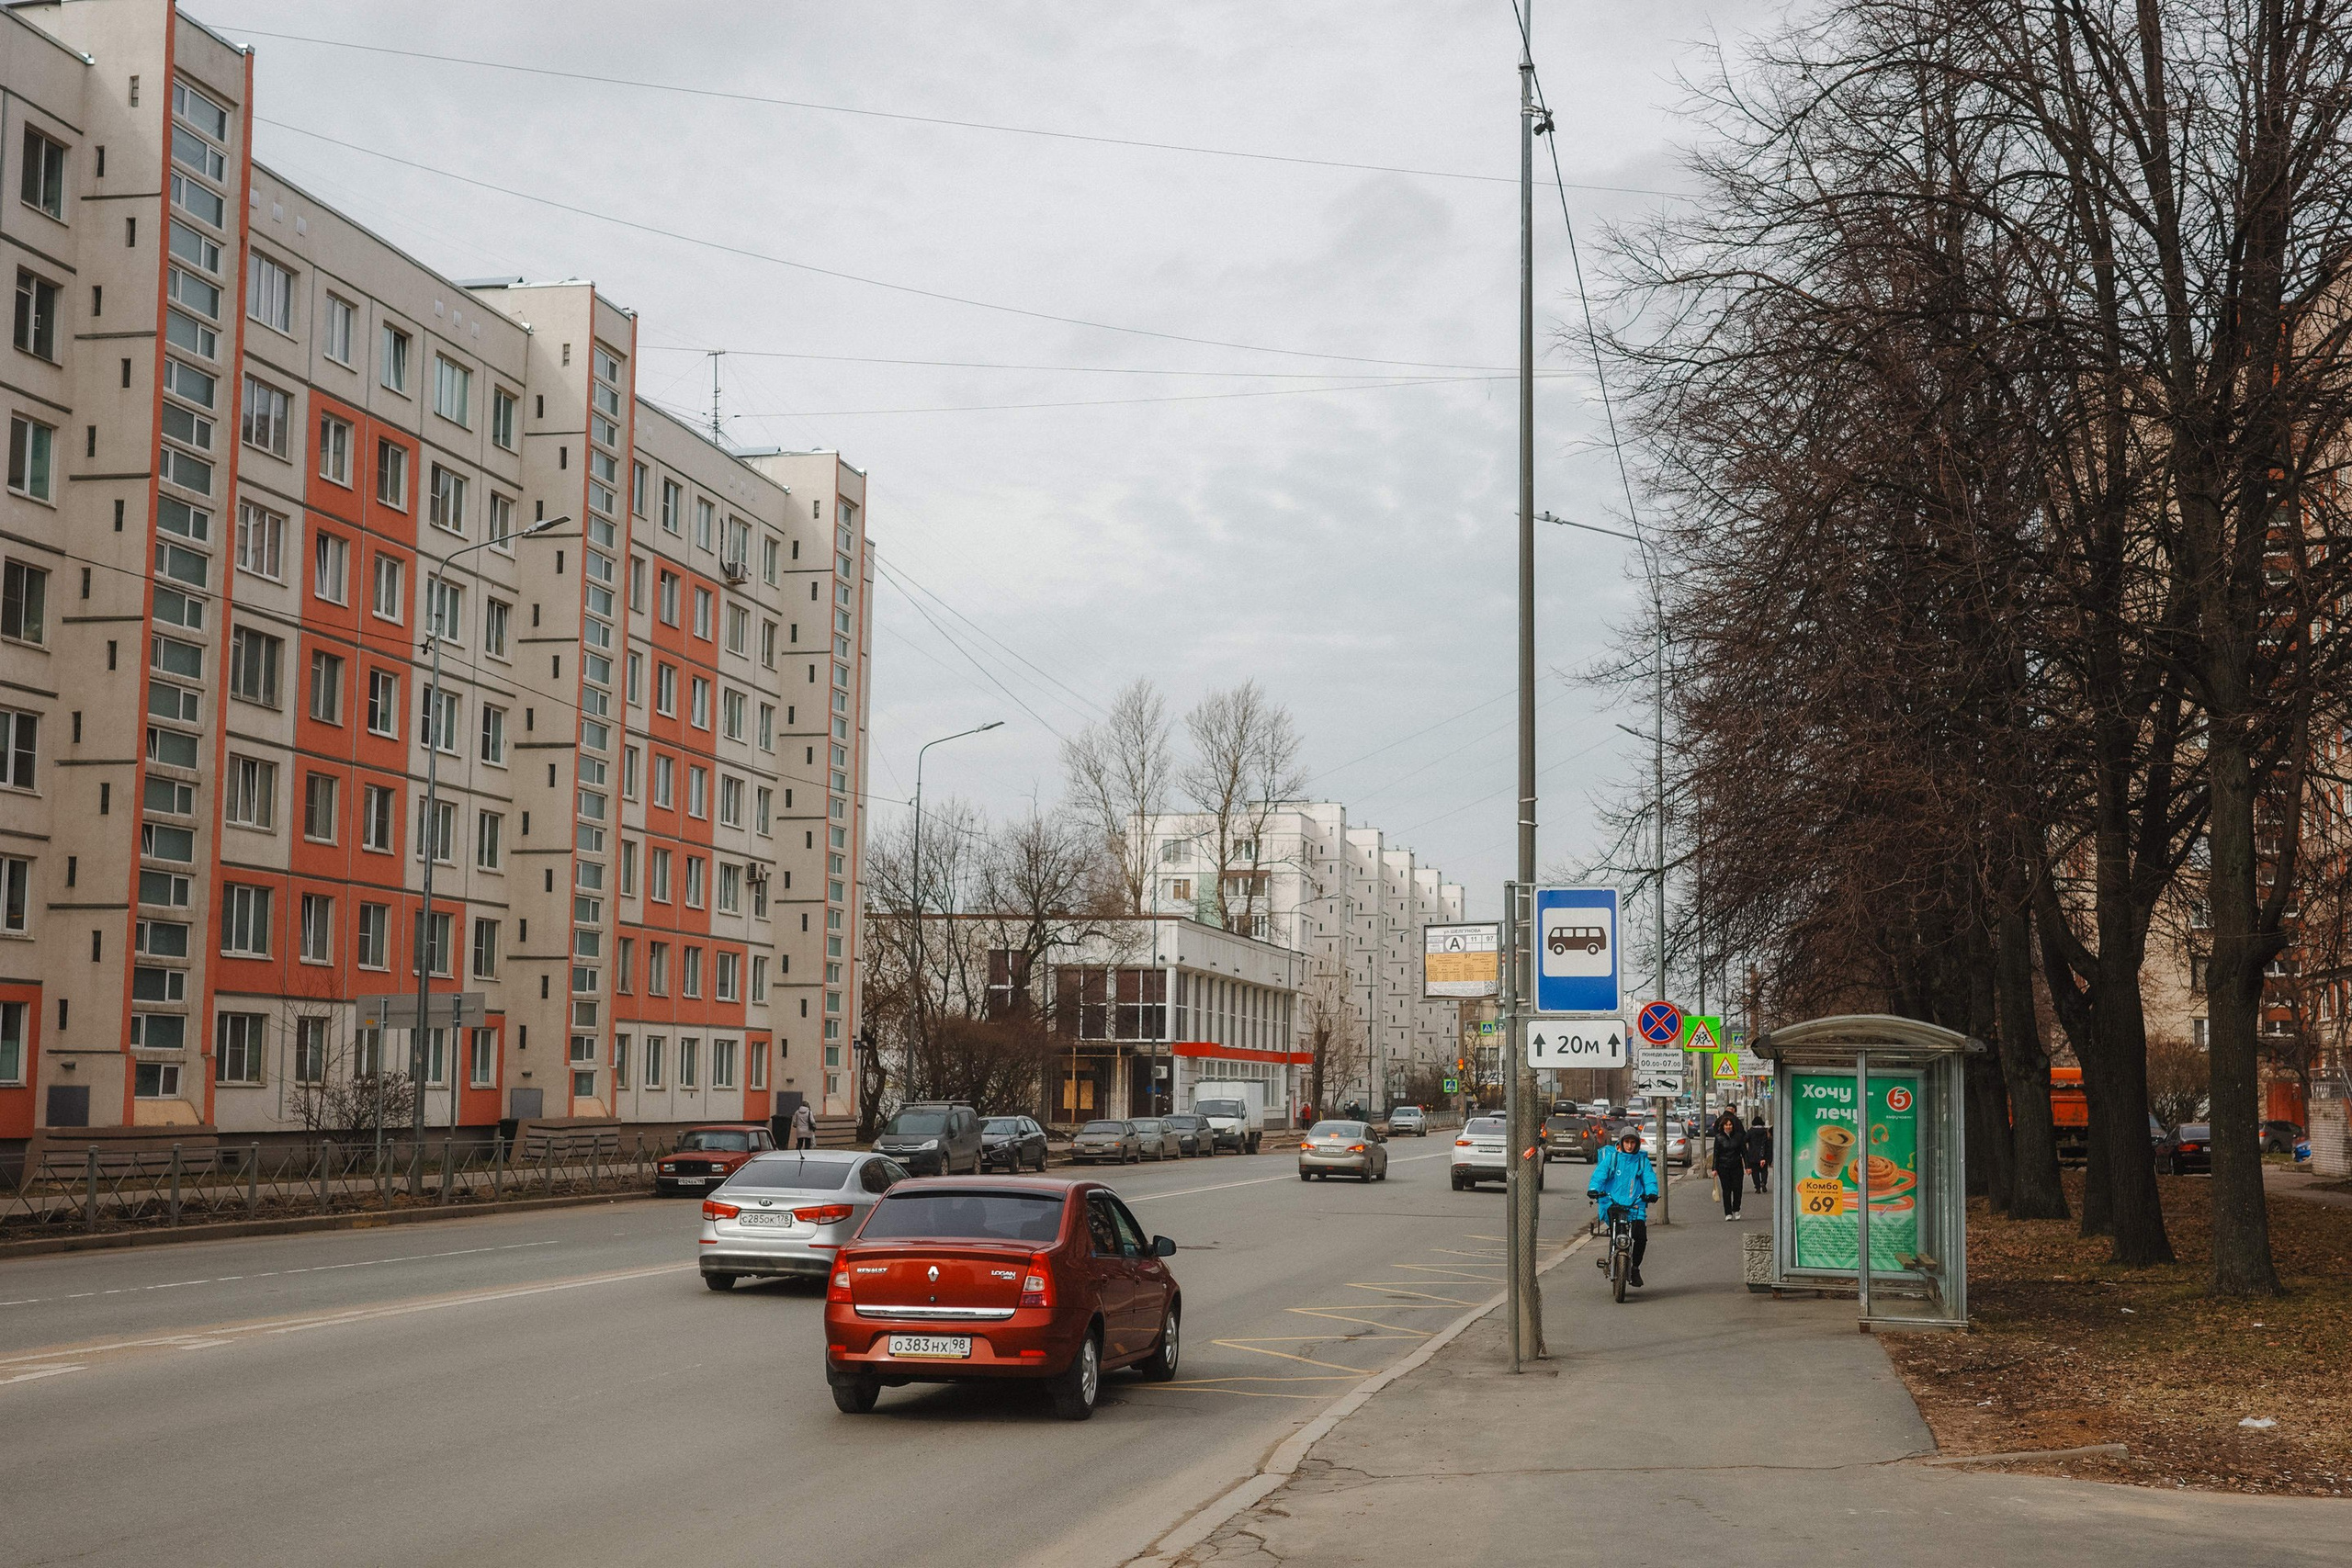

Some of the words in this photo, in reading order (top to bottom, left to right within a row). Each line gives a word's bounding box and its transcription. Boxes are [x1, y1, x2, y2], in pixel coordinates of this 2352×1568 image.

[1802, 1084, 1852, 1103] Хочу
[1806, 1181, 1838, 1190] Комбо
[1809, 1196, 1835, 1213] 69
[952, 1338, 966, 1349] 98
